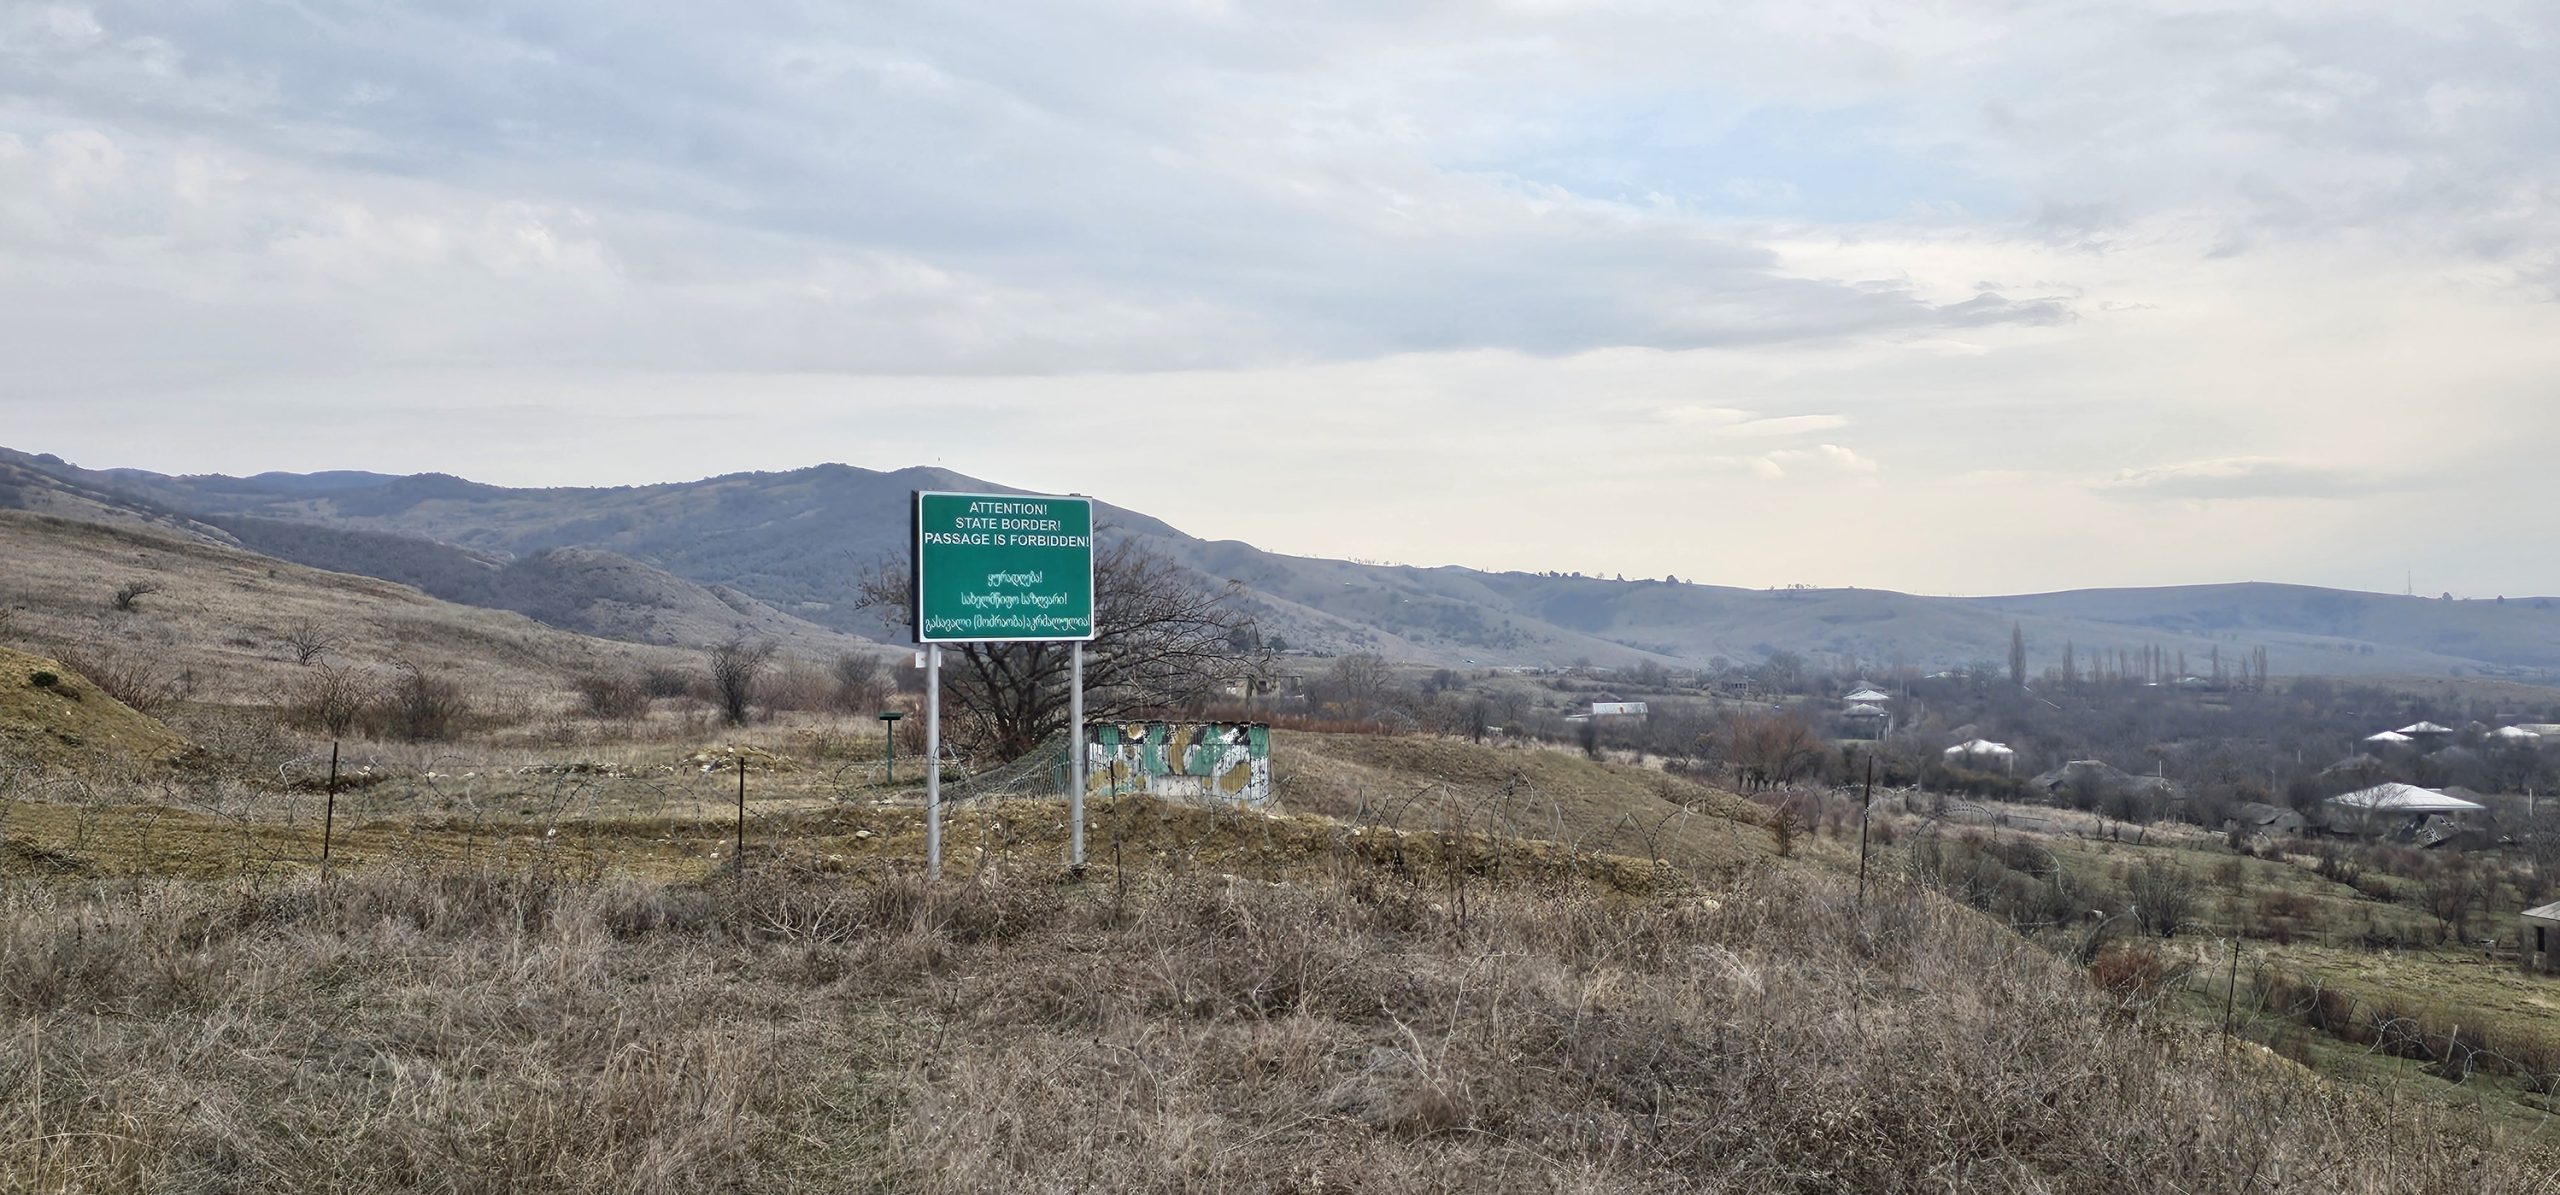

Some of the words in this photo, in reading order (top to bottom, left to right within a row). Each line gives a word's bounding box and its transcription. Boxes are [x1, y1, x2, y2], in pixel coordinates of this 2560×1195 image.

[970, 502, 1047, 515] ATTENTION!
[956, 517, 997, 530] STATE
[1002, 518, 1061, 531] BORDER!
[925, 533, 990, 545] PASSAGE
[994, 535, 1006, 545] IS
[1010, 536, 1090, 548] FORBIDDEN!
[988, 570, 1043, 587] ყურადღება!
[961, 592, 1020, 609] სახელმწიფო
[1021, 592, 1068, 609] საზღვარი!
[926, 614, 972, 632] გასავალი
